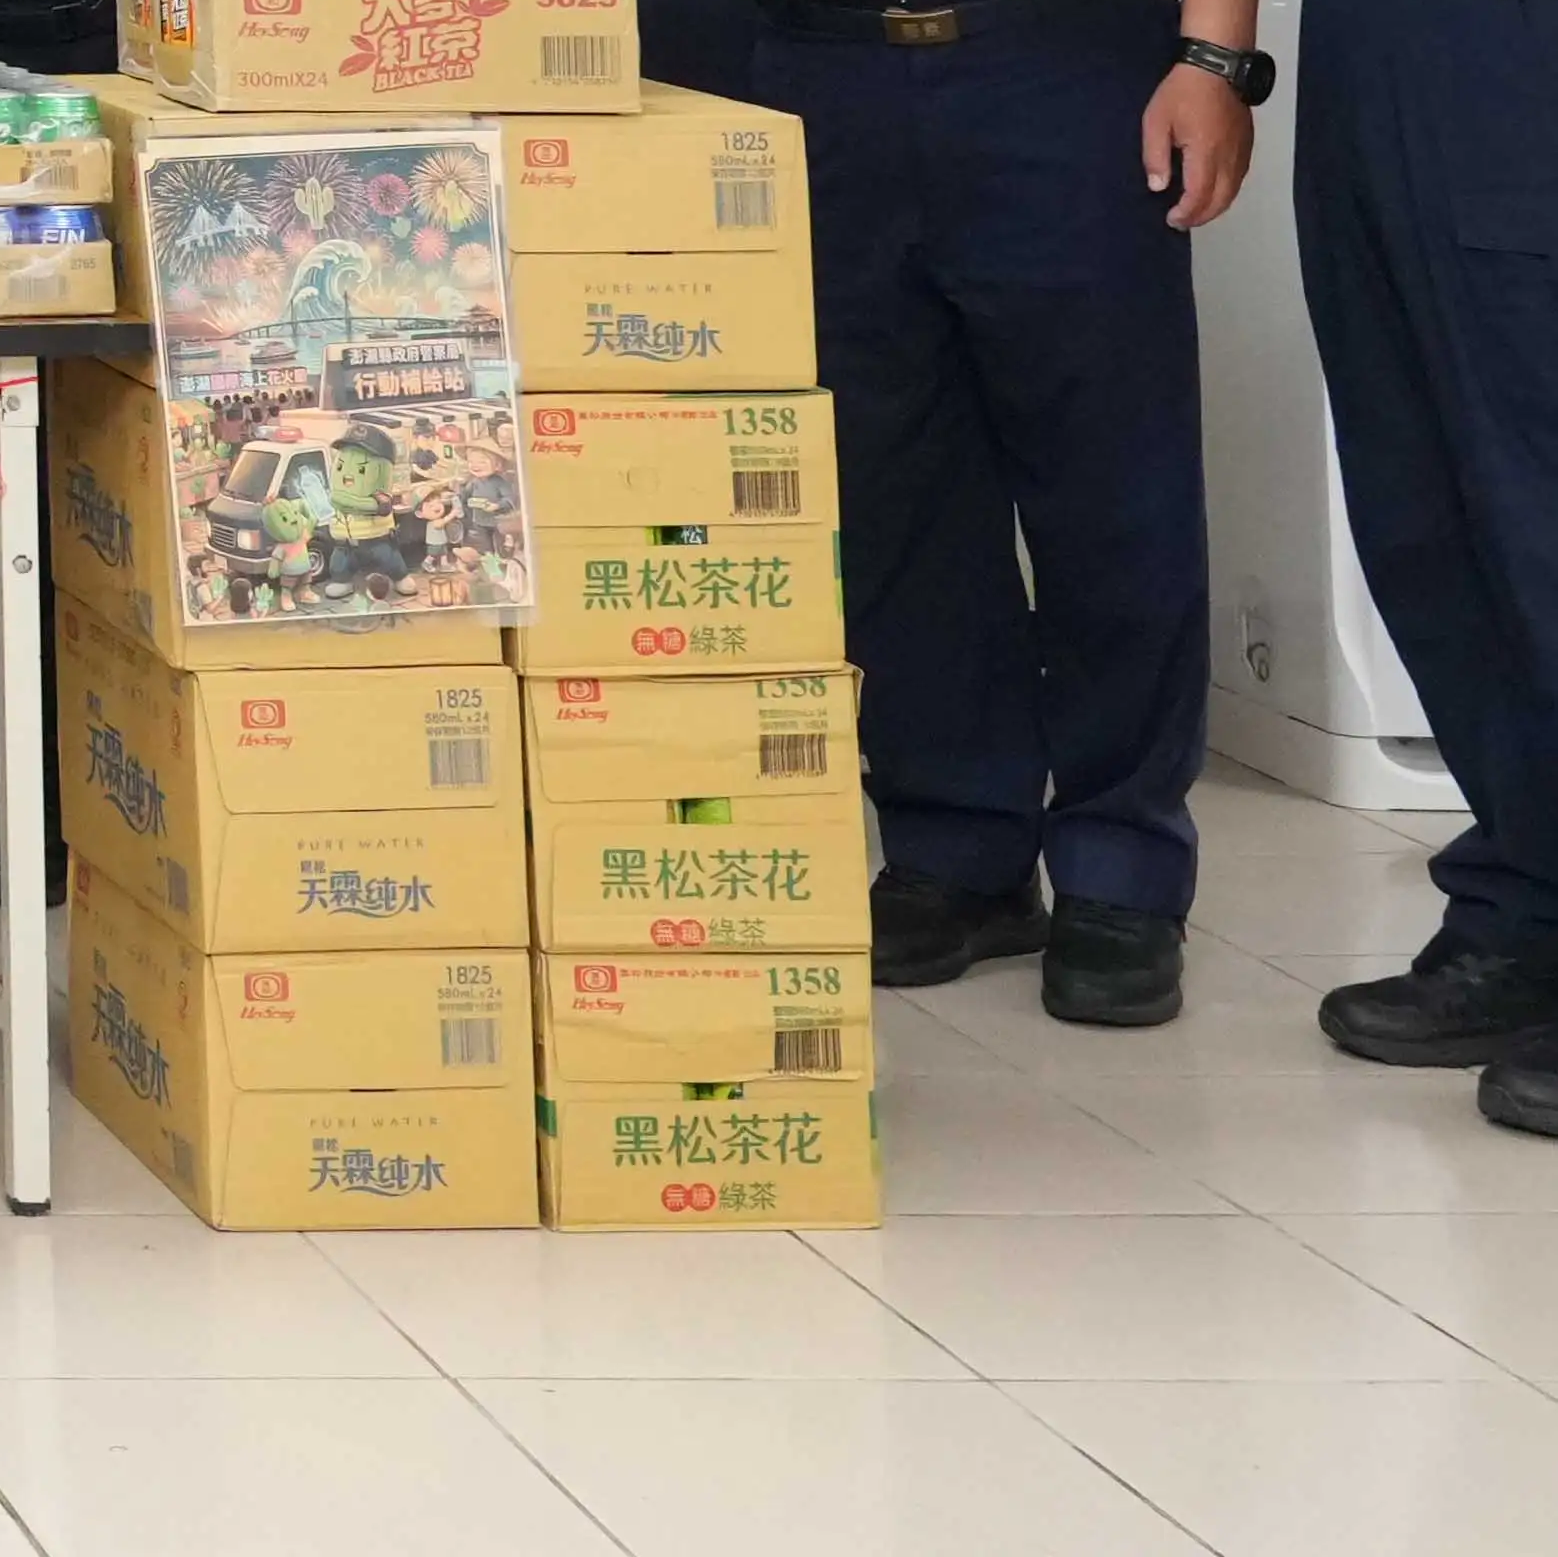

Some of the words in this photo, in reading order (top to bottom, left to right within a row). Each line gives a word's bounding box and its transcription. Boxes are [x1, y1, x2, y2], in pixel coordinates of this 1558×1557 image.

[372, 68, 443, 93] BLACK
[721, 131, 769, 151] 1825
[354, 368, 466, 400] 行動補給站
[722, 407, 799, 436] 1358
[583, 556, 792, 611] 黑松茶花
[689, 624, 748, 655] 綠茶
[436, 688, 482, 709] 1825
[600, 848, 811, 902] 黑松茶花
[708, 917, 767, 947] 綠茶
[446, 965, 492, 985] 1825
[766, 967, 842, 996] 1358
[612, 1112, 823, 1167] 黑松茶花
[718, 1182, 776, 1212] 綠茶
